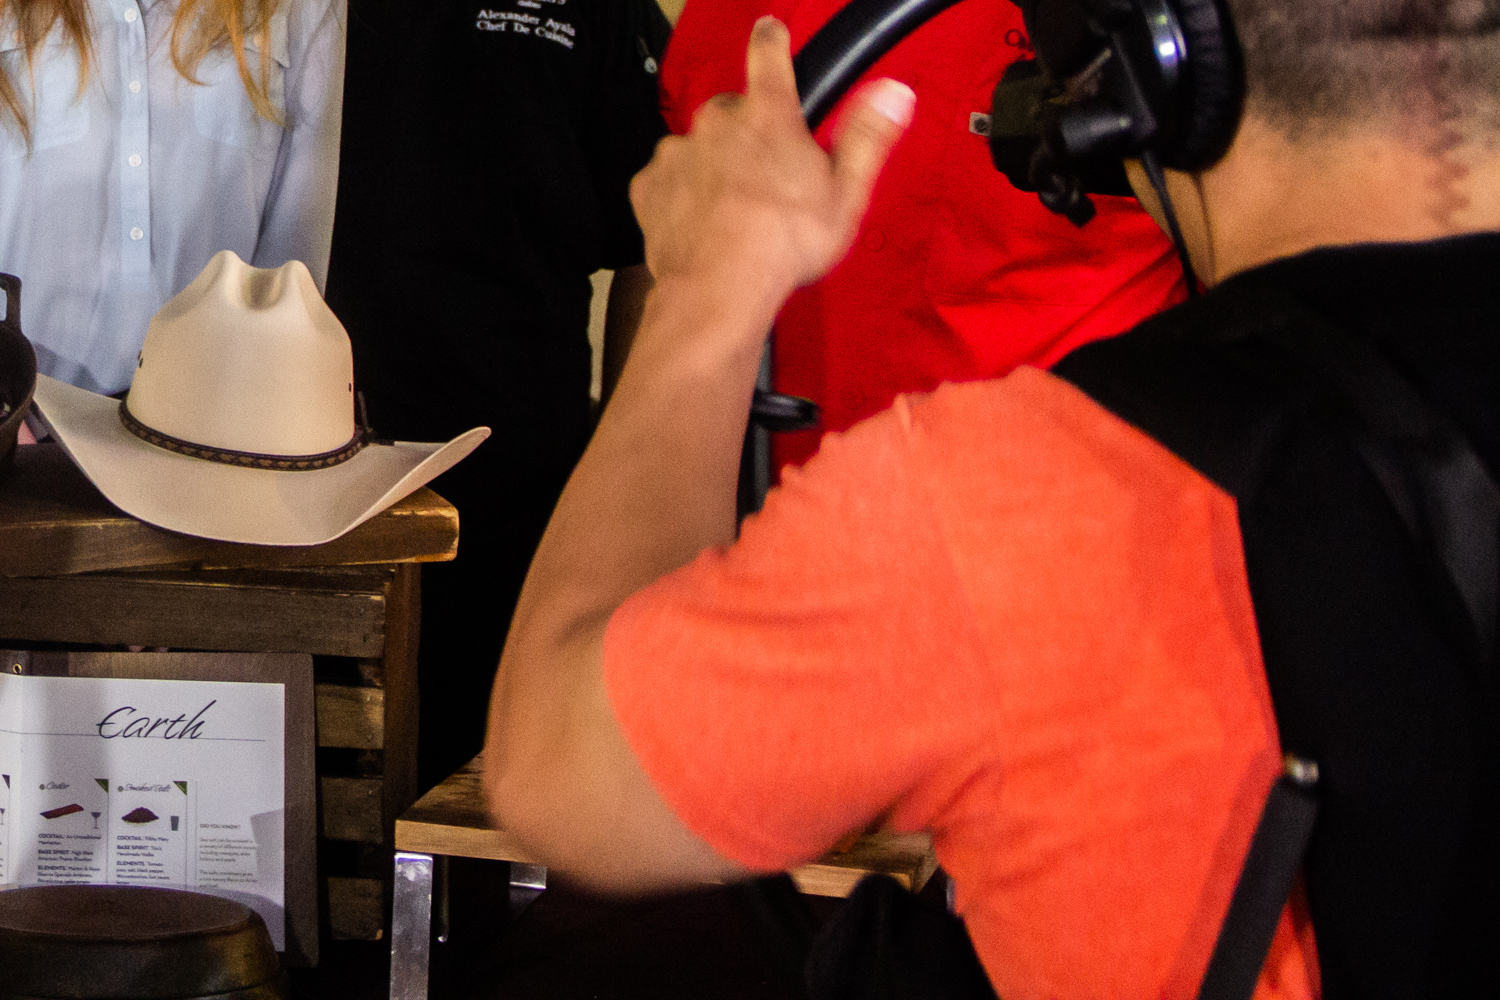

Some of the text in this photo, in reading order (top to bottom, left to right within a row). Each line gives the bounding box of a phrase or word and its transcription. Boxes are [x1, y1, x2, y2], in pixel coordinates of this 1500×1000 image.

[477, 8, 541, 26] Alexander
[476, 20, 507, 32] Chef
[513, 21, 531, 35] De
[95, 699, 217, 740] Earth
